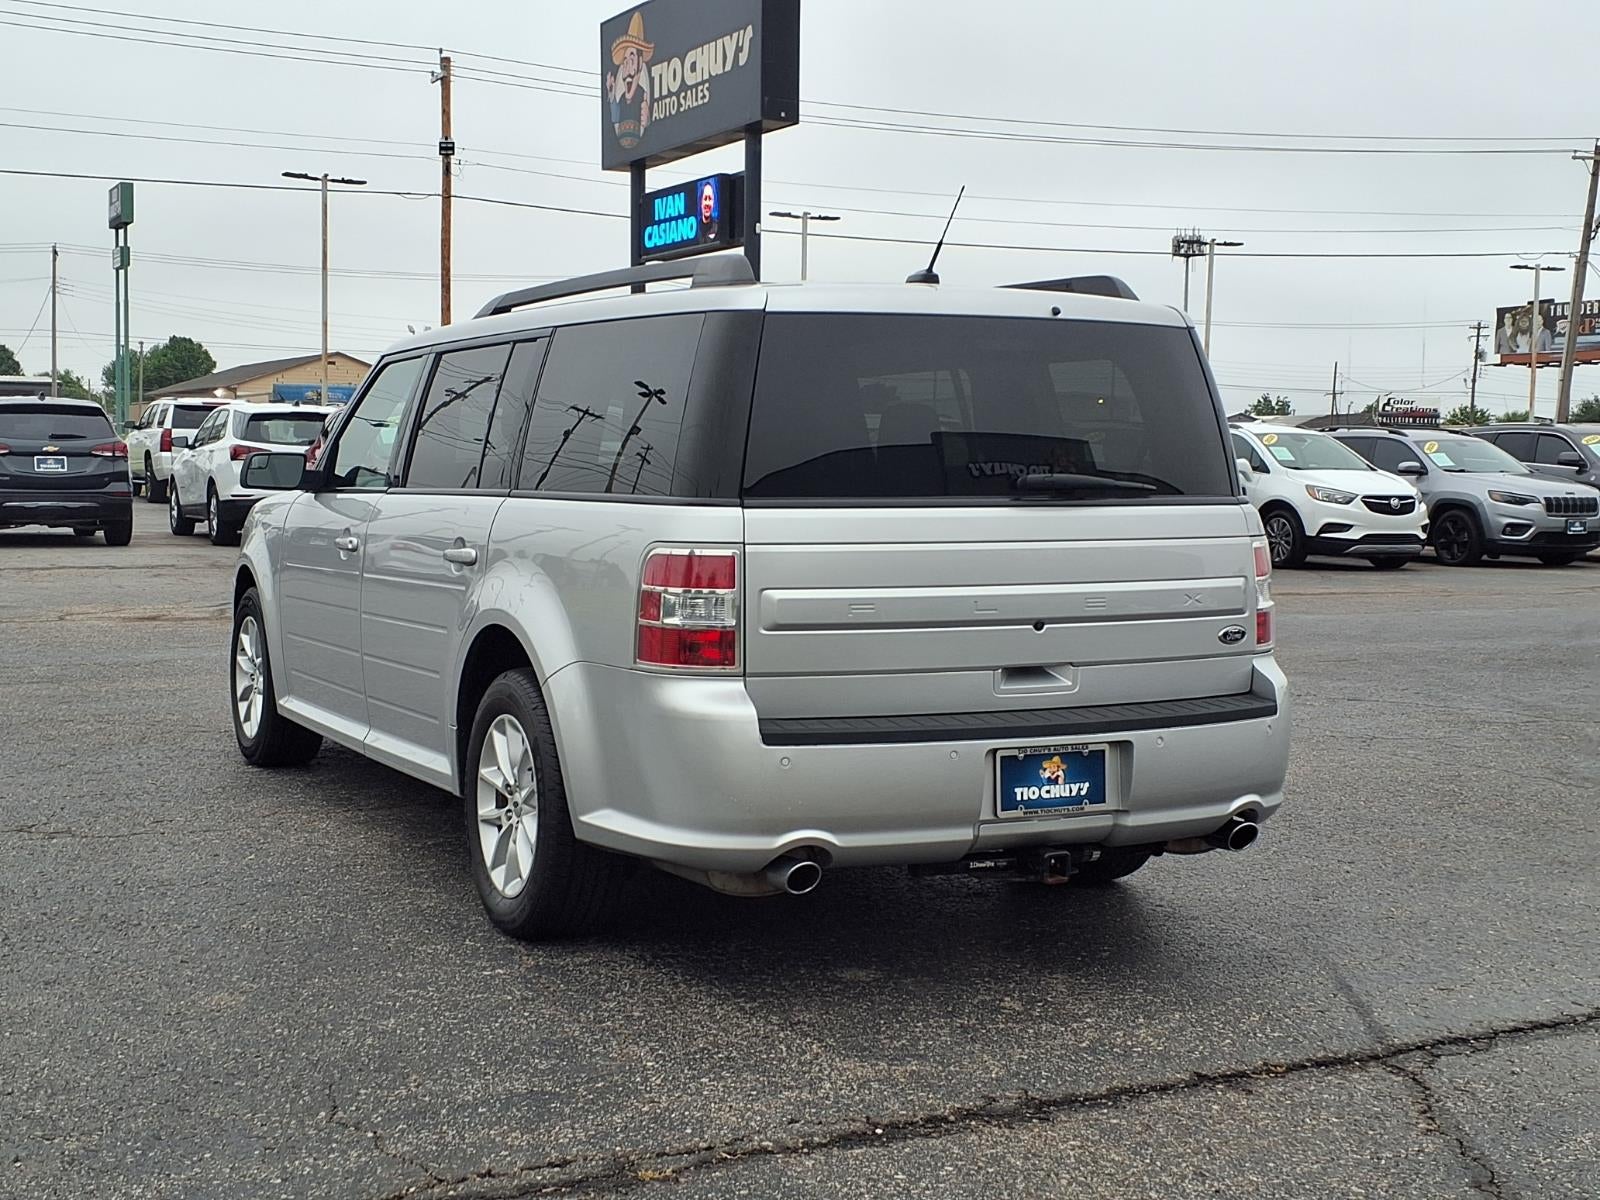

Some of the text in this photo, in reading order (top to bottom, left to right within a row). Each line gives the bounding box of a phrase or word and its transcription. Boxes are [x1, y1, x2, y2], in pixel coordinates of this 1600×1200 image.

[651, 24, 754, 99] TIO CHUY'S
[652, 83, 710, 122] AUTO SALES
[644, 191, 697, 249] IVAN CASIANO
[1550, 302, 1599, 316] THUDER
[1381, 403, 1439, 413] Creations
[1385, 397, 1416, 406] Color
[1014, 781, 1090, 801] TIO CHUY'S
